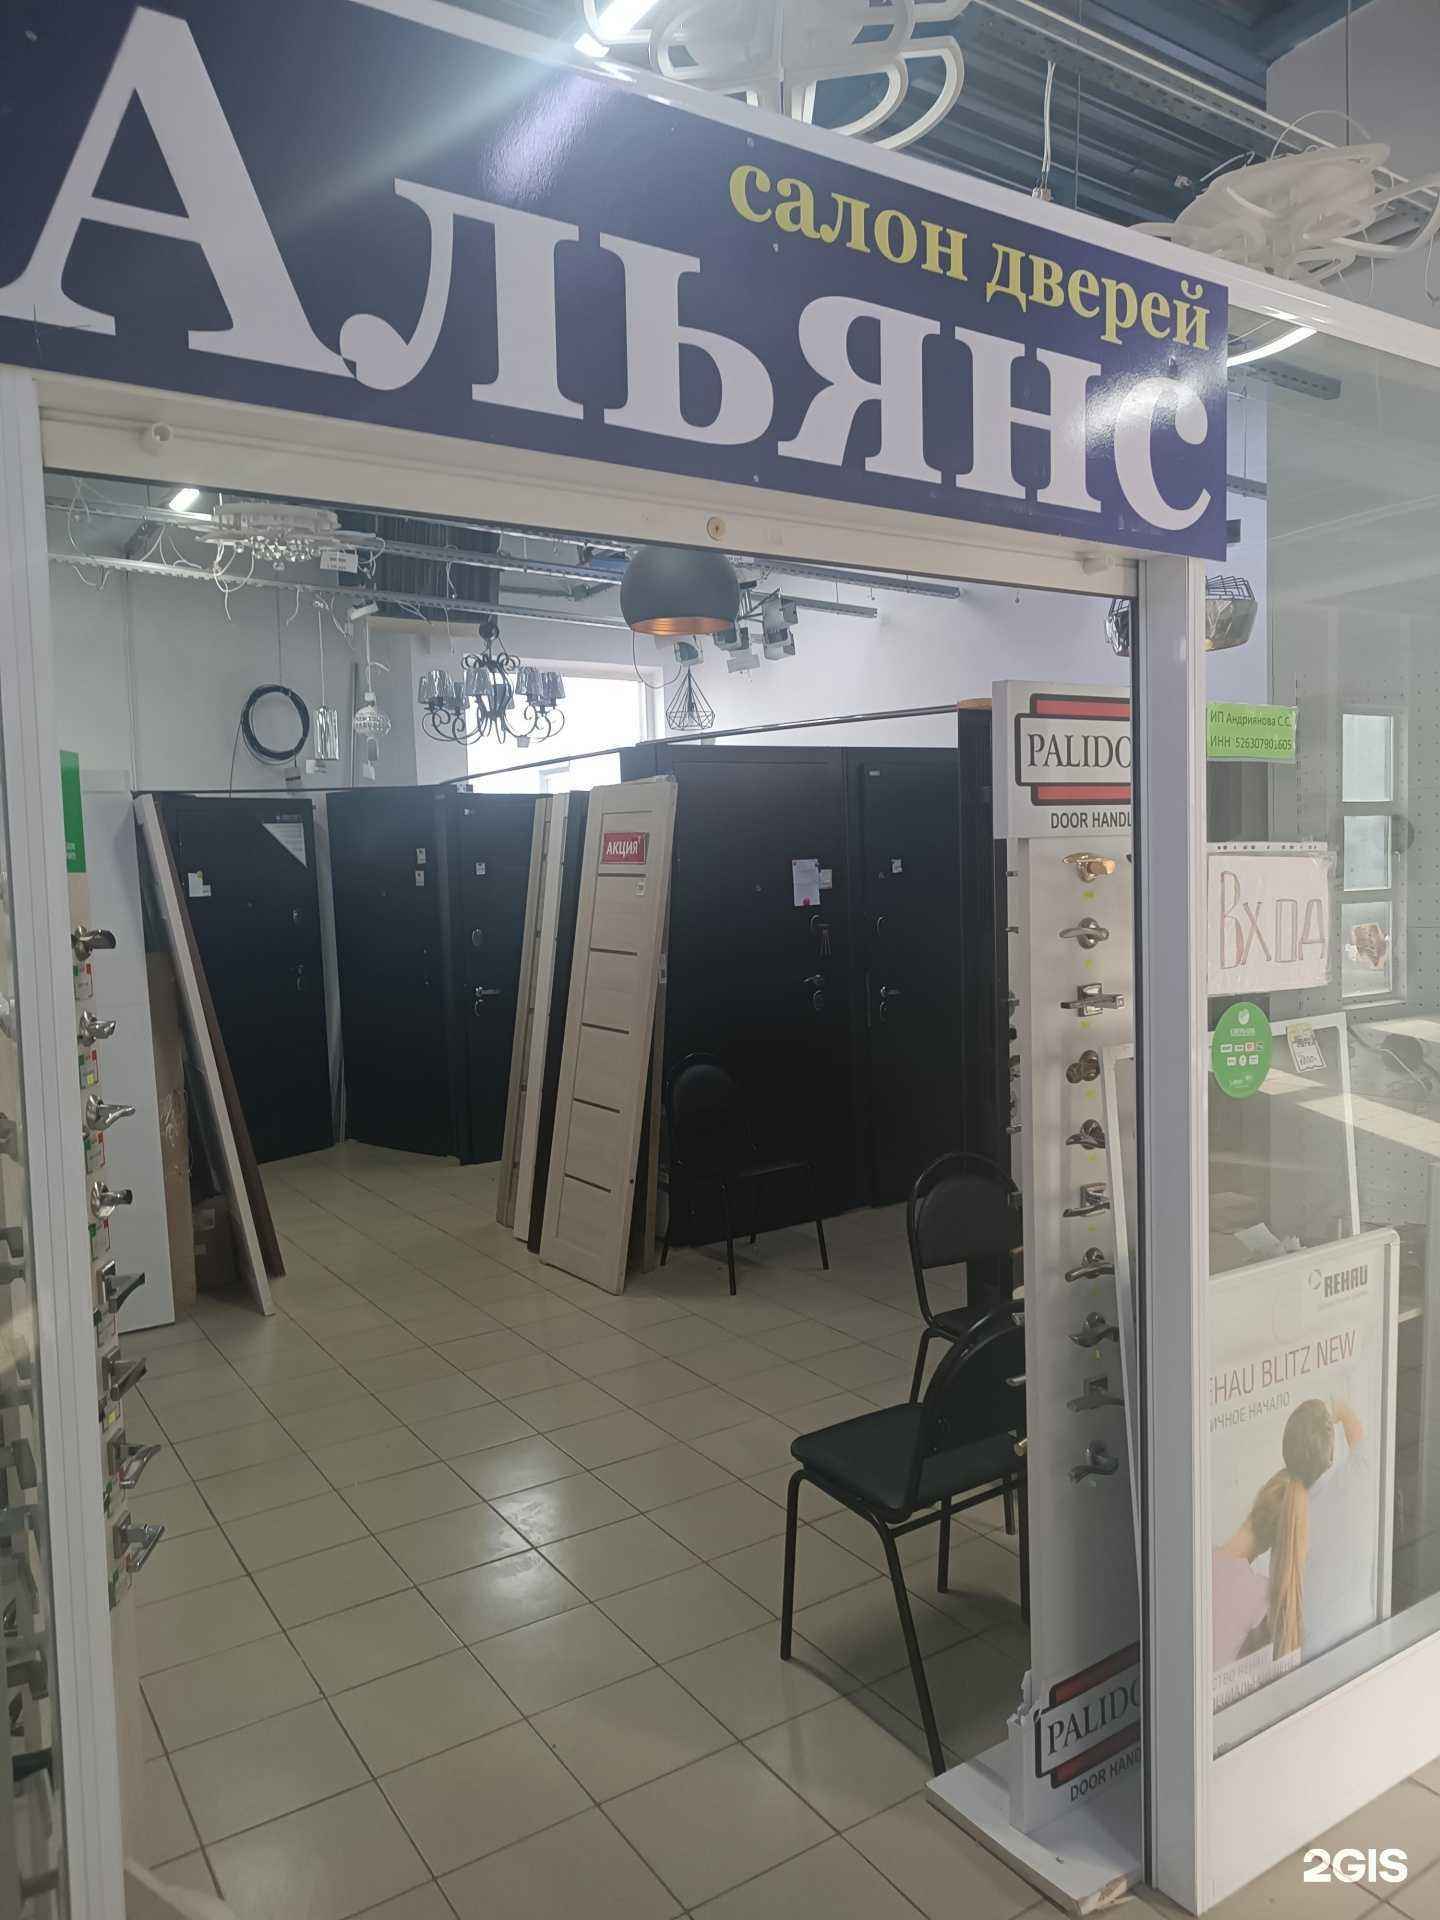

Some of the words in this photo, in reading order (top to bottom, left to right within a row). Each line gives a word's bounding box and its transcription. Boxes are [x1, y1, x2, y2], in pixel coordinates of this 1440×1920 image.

[0, 6, 1211, 531] Альянс
[729, 164, 968, 281] салон
[986, 242, 1210, 350] дверей
[1210, 710, 1224, 723] ИП
[1210, 735, 1231, 748] ИНН
[1051, 812, 1088, 829] DOOR
[606, 840, 638, 858] АКЦИЯ
[1323, 1264, 1368, 1298] REHAU
[1261, 1344, 1311, 1388] BLITZ
[1316, 1329, 1356, 1369] NEW
[1249, 1391, 1290, 1420] НАЧАЛО
[1070, 1768, 1107, 1801] DOOR
